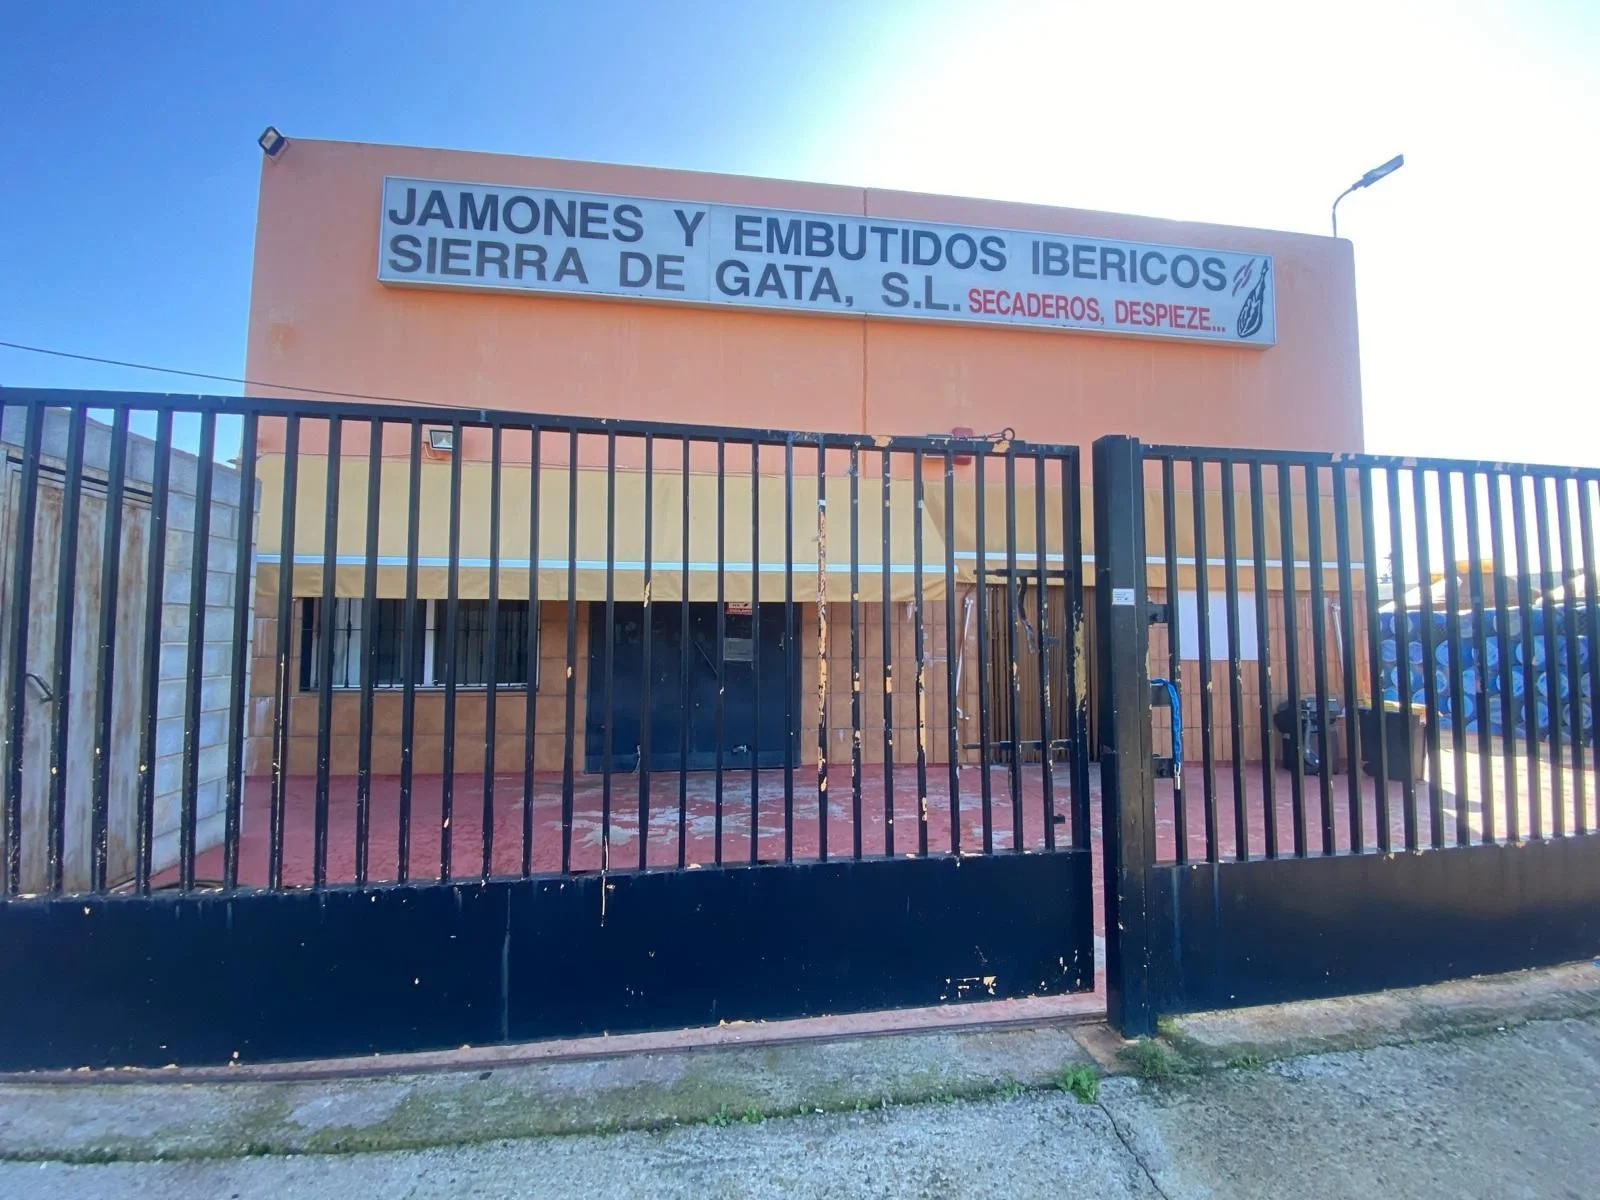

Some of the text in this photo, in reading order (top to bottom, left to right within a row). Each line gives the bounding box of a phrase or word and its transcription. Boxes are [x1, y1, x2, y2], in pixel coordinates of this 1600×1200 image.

[388, 188, 1227, 292] JAMONES Y EMBUTIDOS IBERICOS
[388, 234, 961, 312] SIERRA DE GATA, S.L.
[968, 287, 1226, 333] SECADEROS, DESPIEZE...
